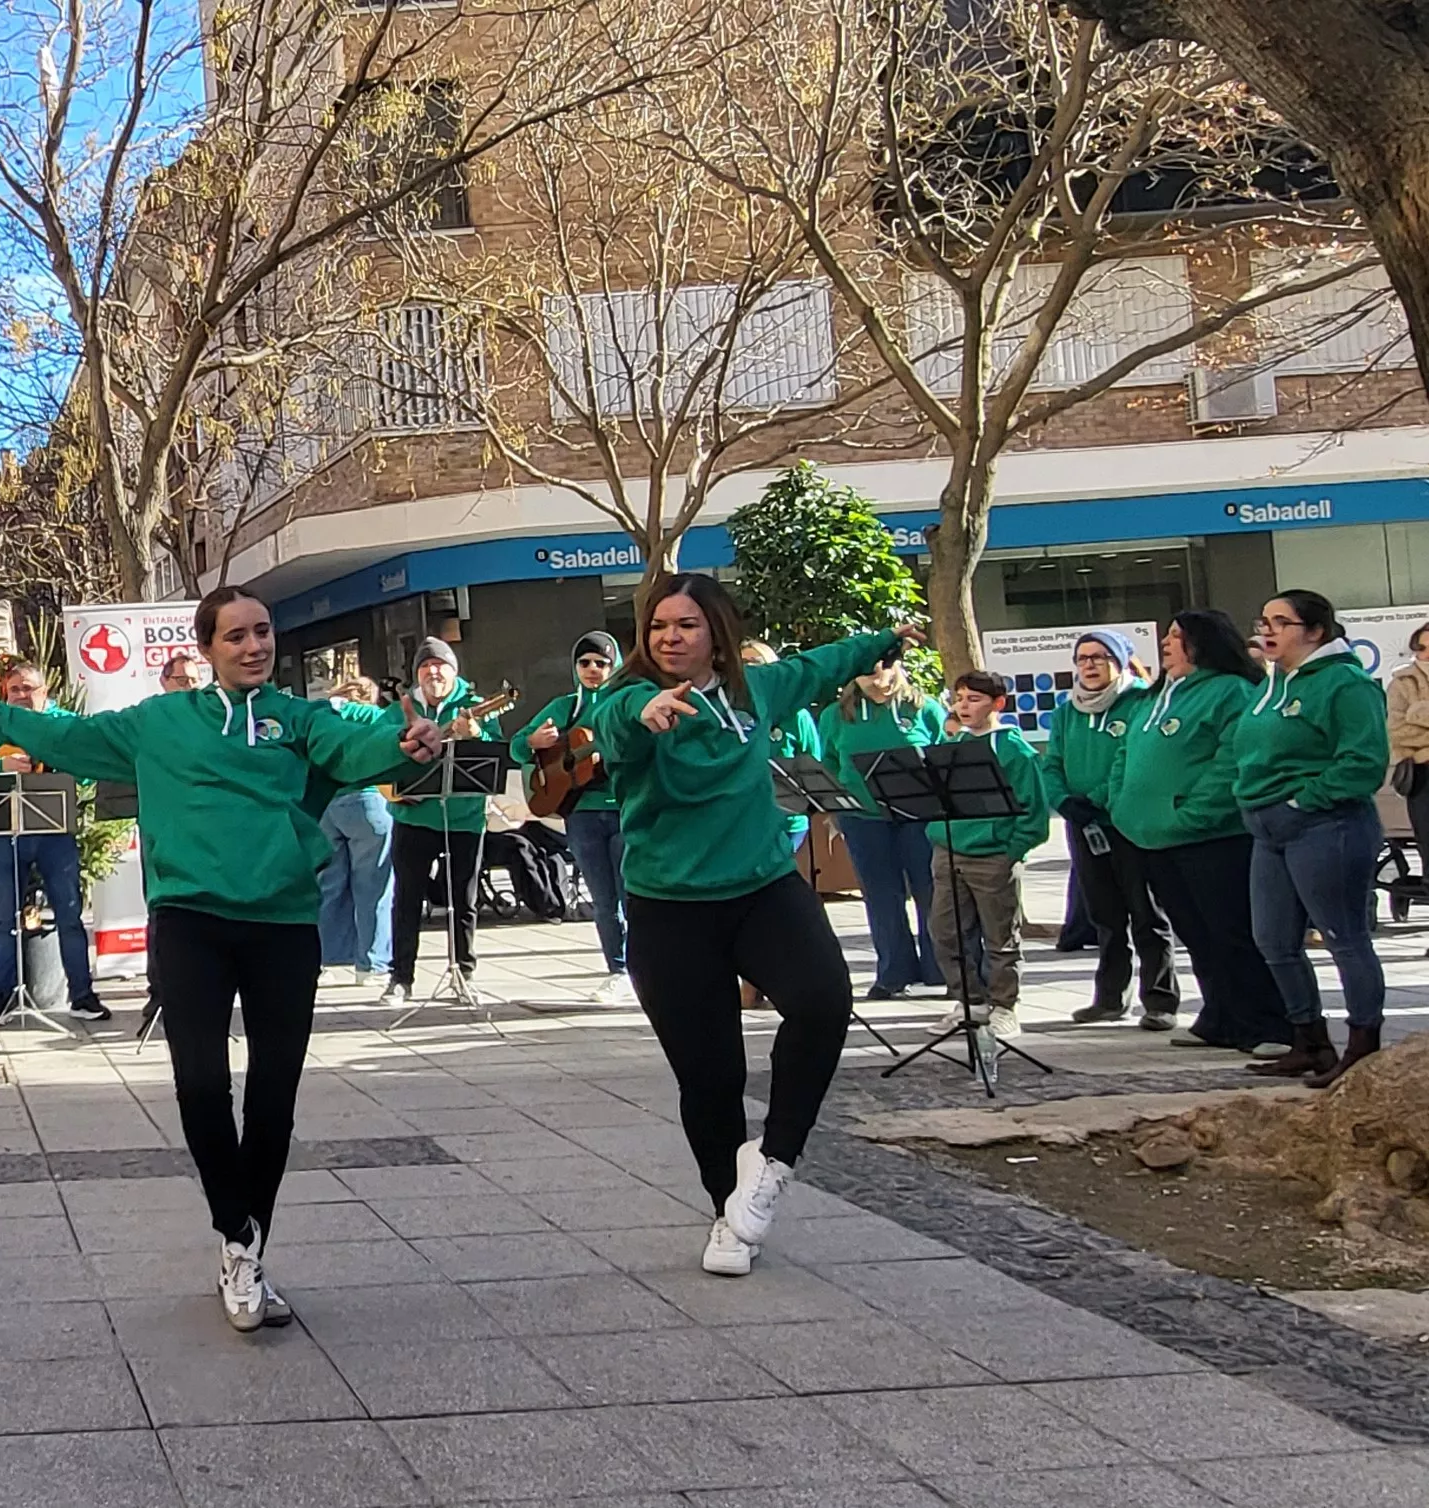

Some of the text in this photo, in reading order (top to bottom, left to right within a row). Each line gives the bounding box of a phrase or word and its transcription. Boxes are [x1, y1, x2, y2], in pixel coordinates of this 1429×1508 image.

[1239, 500, 1331, 524] Sabadell
[550, 545, 641, 569] Sabadell
[143, 615, 195, 624] ENTARACH
